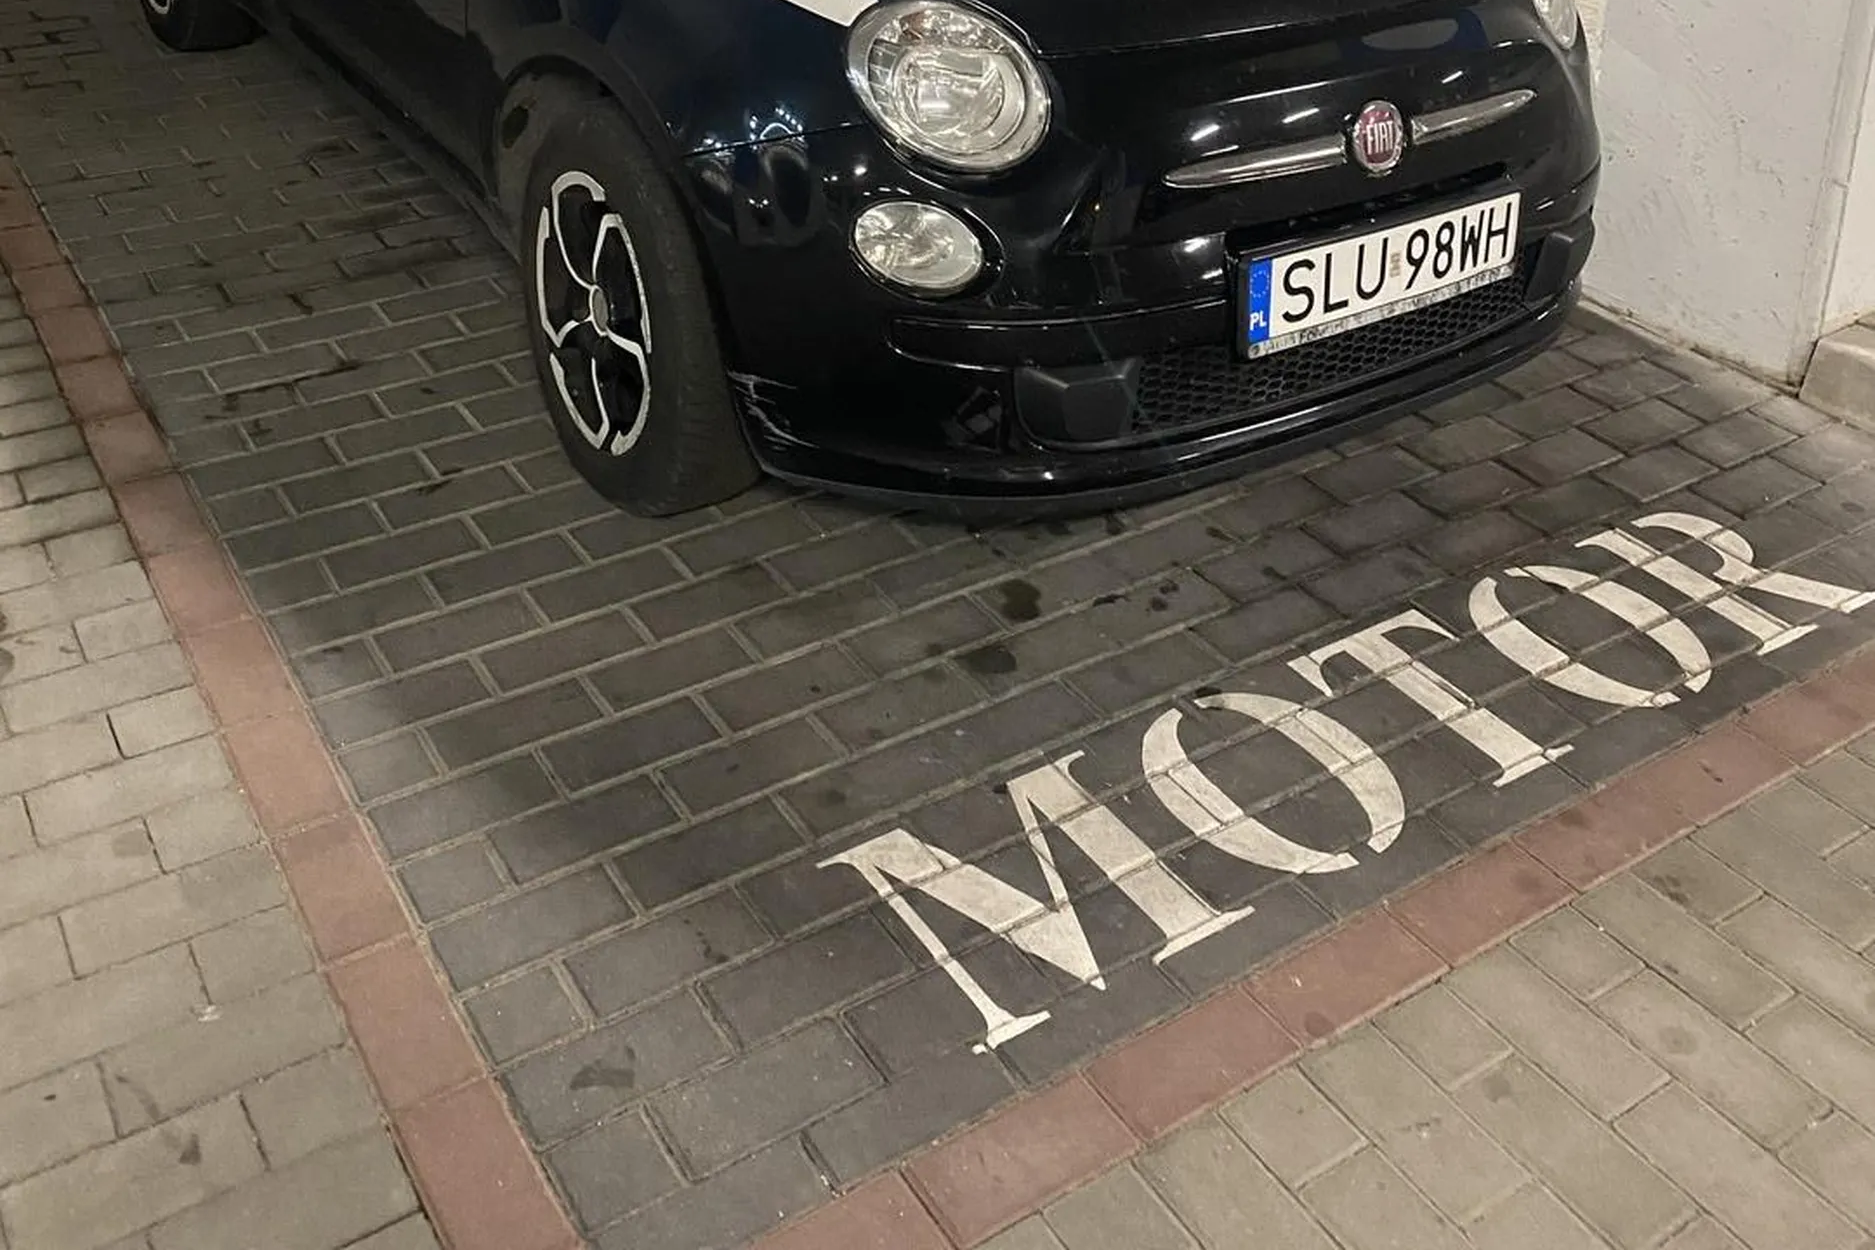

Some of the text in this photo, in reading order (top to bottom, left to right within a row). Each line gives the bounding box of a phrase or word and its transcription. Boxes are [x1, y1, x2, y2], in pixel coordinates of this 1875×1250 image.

[1366, 120, 1393, 155] FIAT
[1282, 237, 1389, 324] SLU
[1404, 202, 1513, 291] 98WH
[1250, 310, 1267, 331] PL
[816, 511, 1875, 1055] MOTOR
